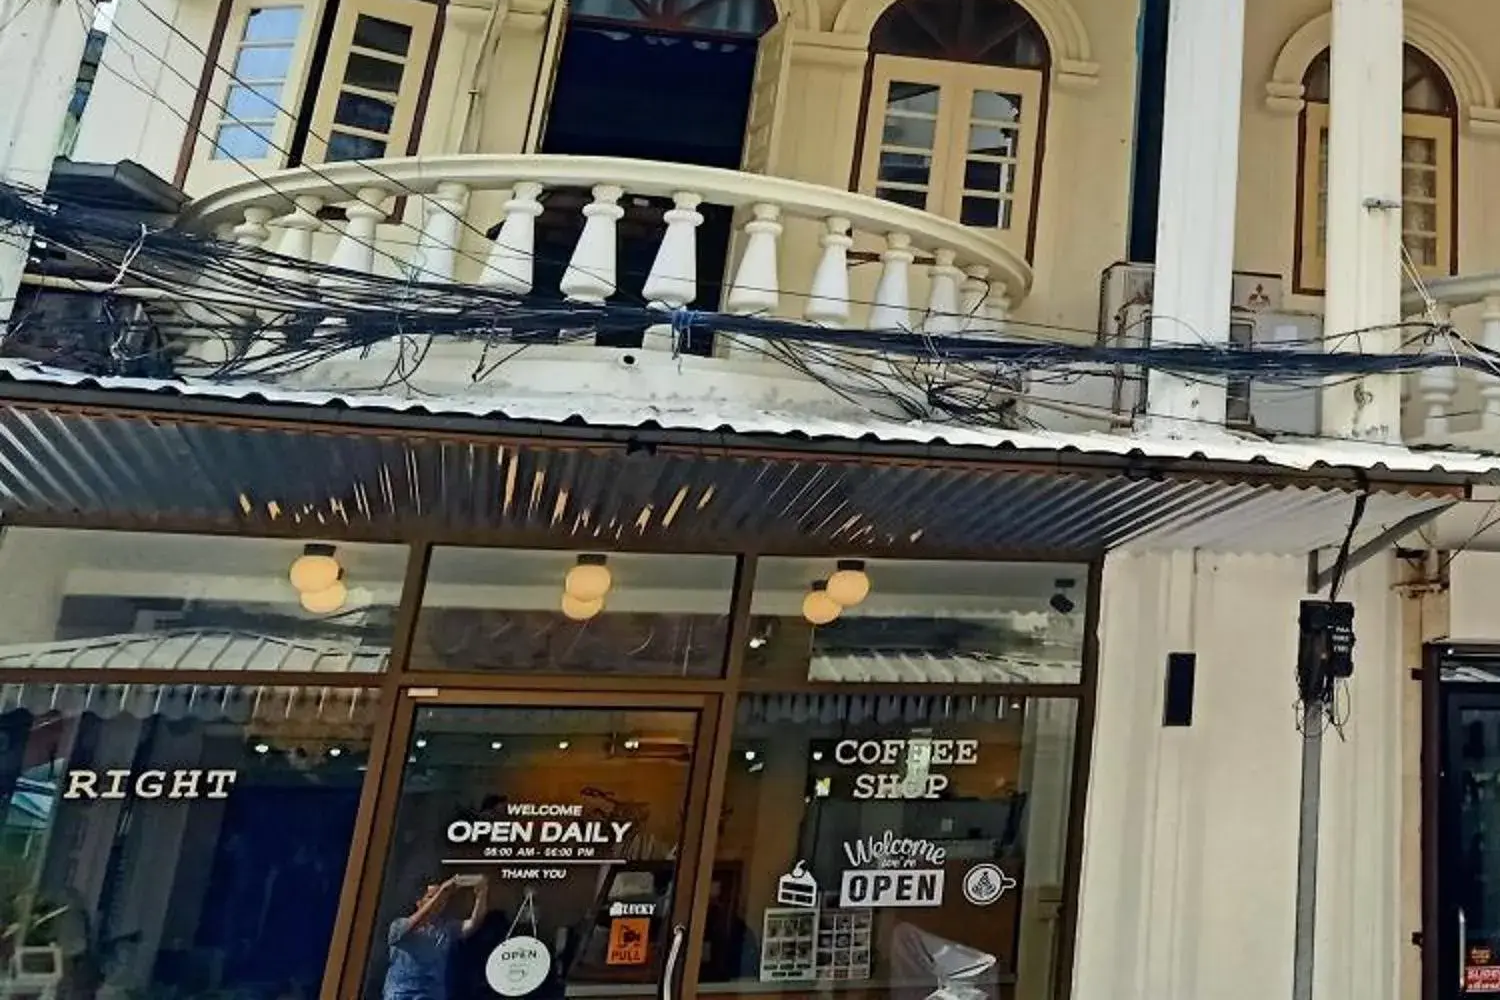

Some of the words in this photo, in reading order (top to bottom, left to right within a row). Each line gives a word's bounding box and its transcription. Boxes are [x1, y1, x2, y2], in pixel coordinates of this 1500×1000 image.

[834, 739, 979, 765] COFFEE
[63, 769, 237, 799] RIGHT
[853, 774, 948, 799] SHOP
[507, 804, 583, 817] WELCOME
[447, 820, 533, 843] OPEN
[540, 821, 632, 843] DAILY
[577, 847, 595, 857] PM
[843, 829, 946, 867] Welcome
[501, 869, 540, 880] THANK
[542, 869, 567, 880] YOU
[849, 874, 937, 901] OPEN
[501, 949, 538, 961] OPEN
